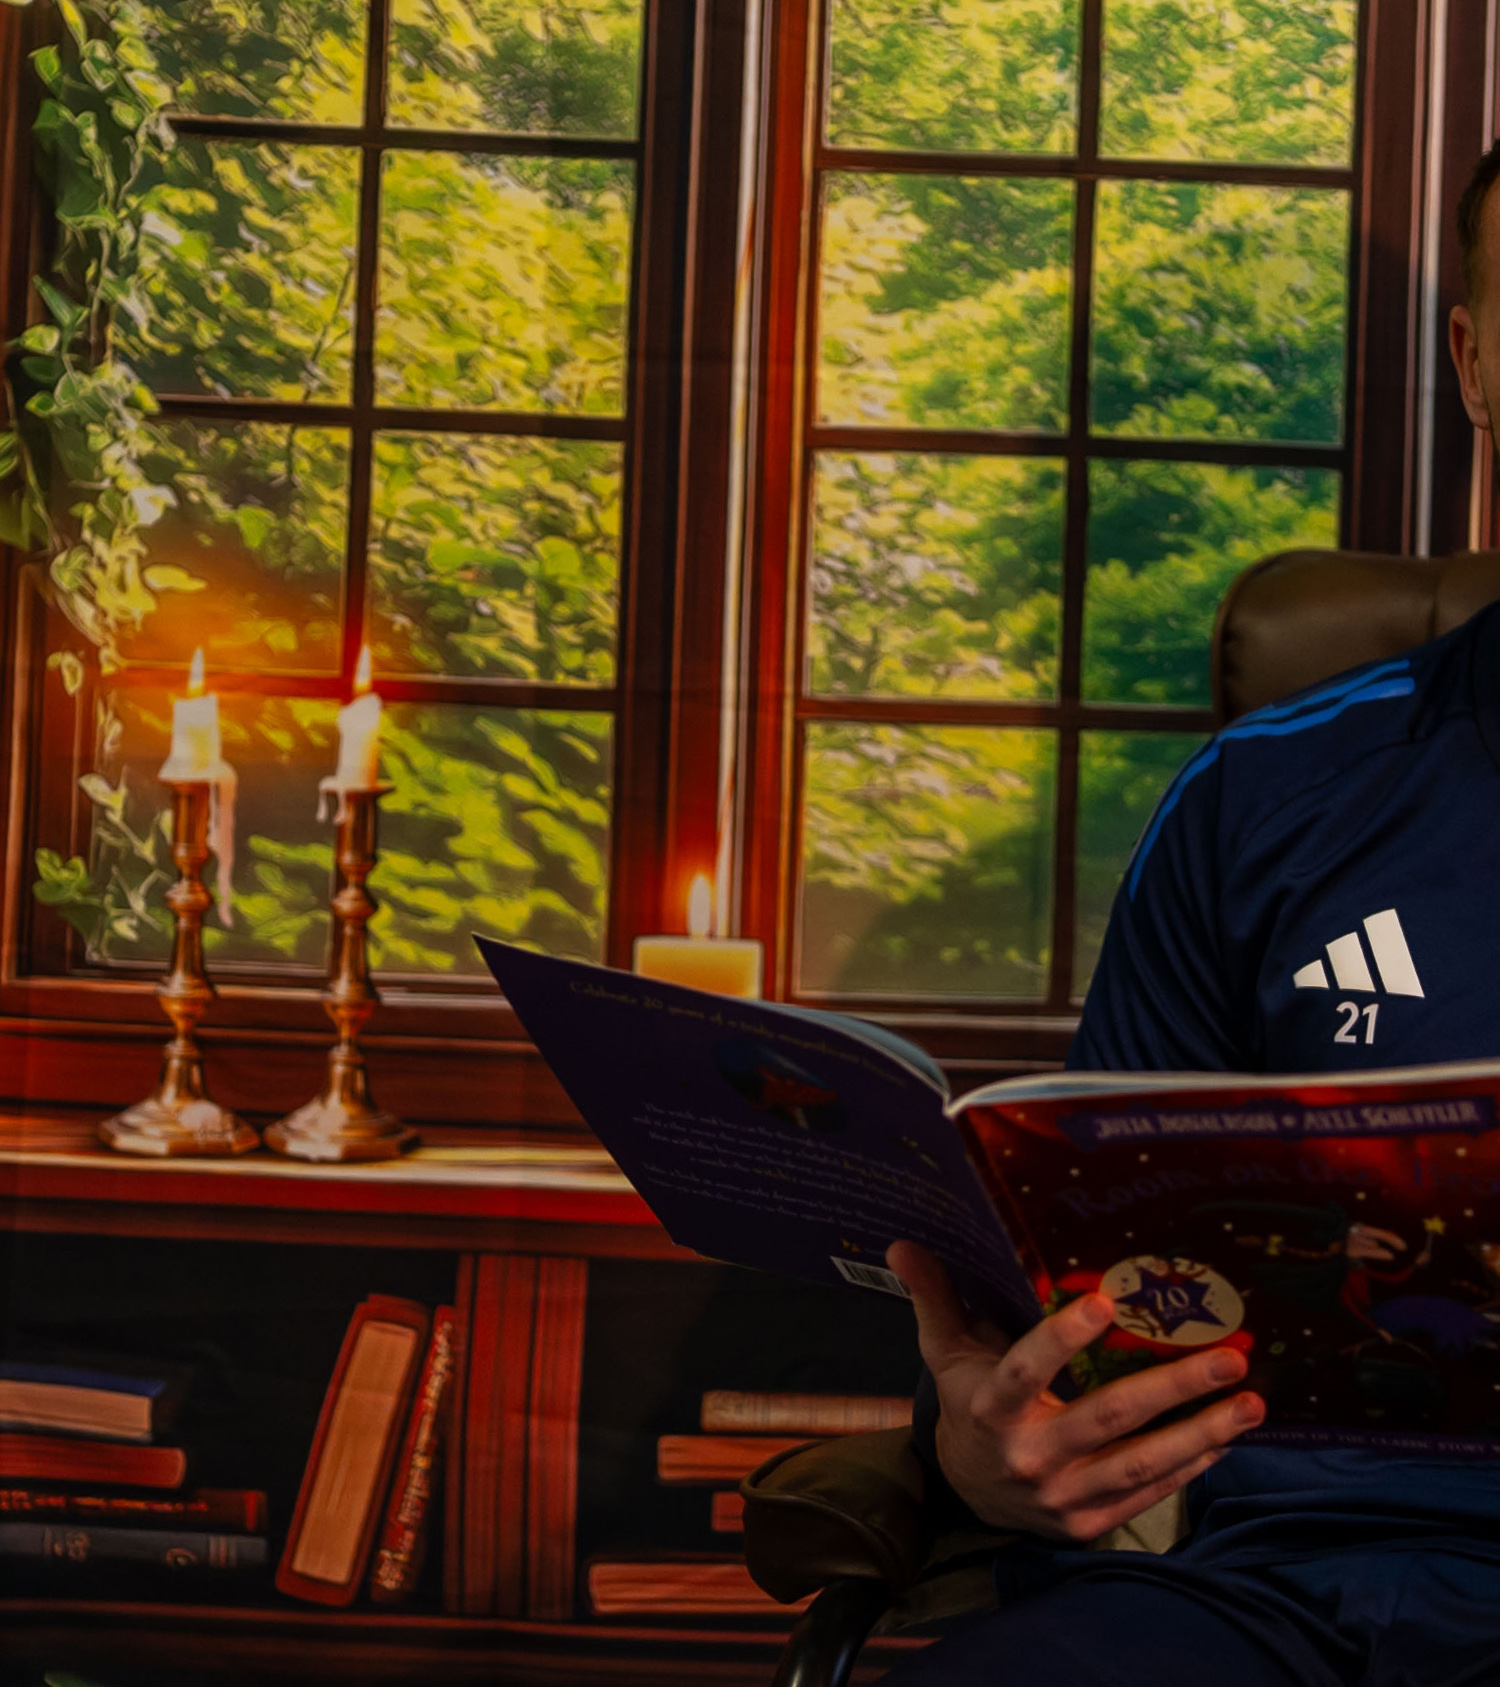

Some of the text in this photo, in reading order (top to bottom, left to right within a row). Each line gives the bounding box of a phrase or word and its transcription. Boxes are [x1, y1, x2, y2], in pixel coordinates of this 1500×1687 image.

[1333, 1000, 1380, 1046] 21
[1097, 1101, 1481, 1140] JULIA DONALDSON AXEL SCHEFFLER
[1055, 1168, 1210, 1221] Room
[1222, 1162, 1291, 1188] on
